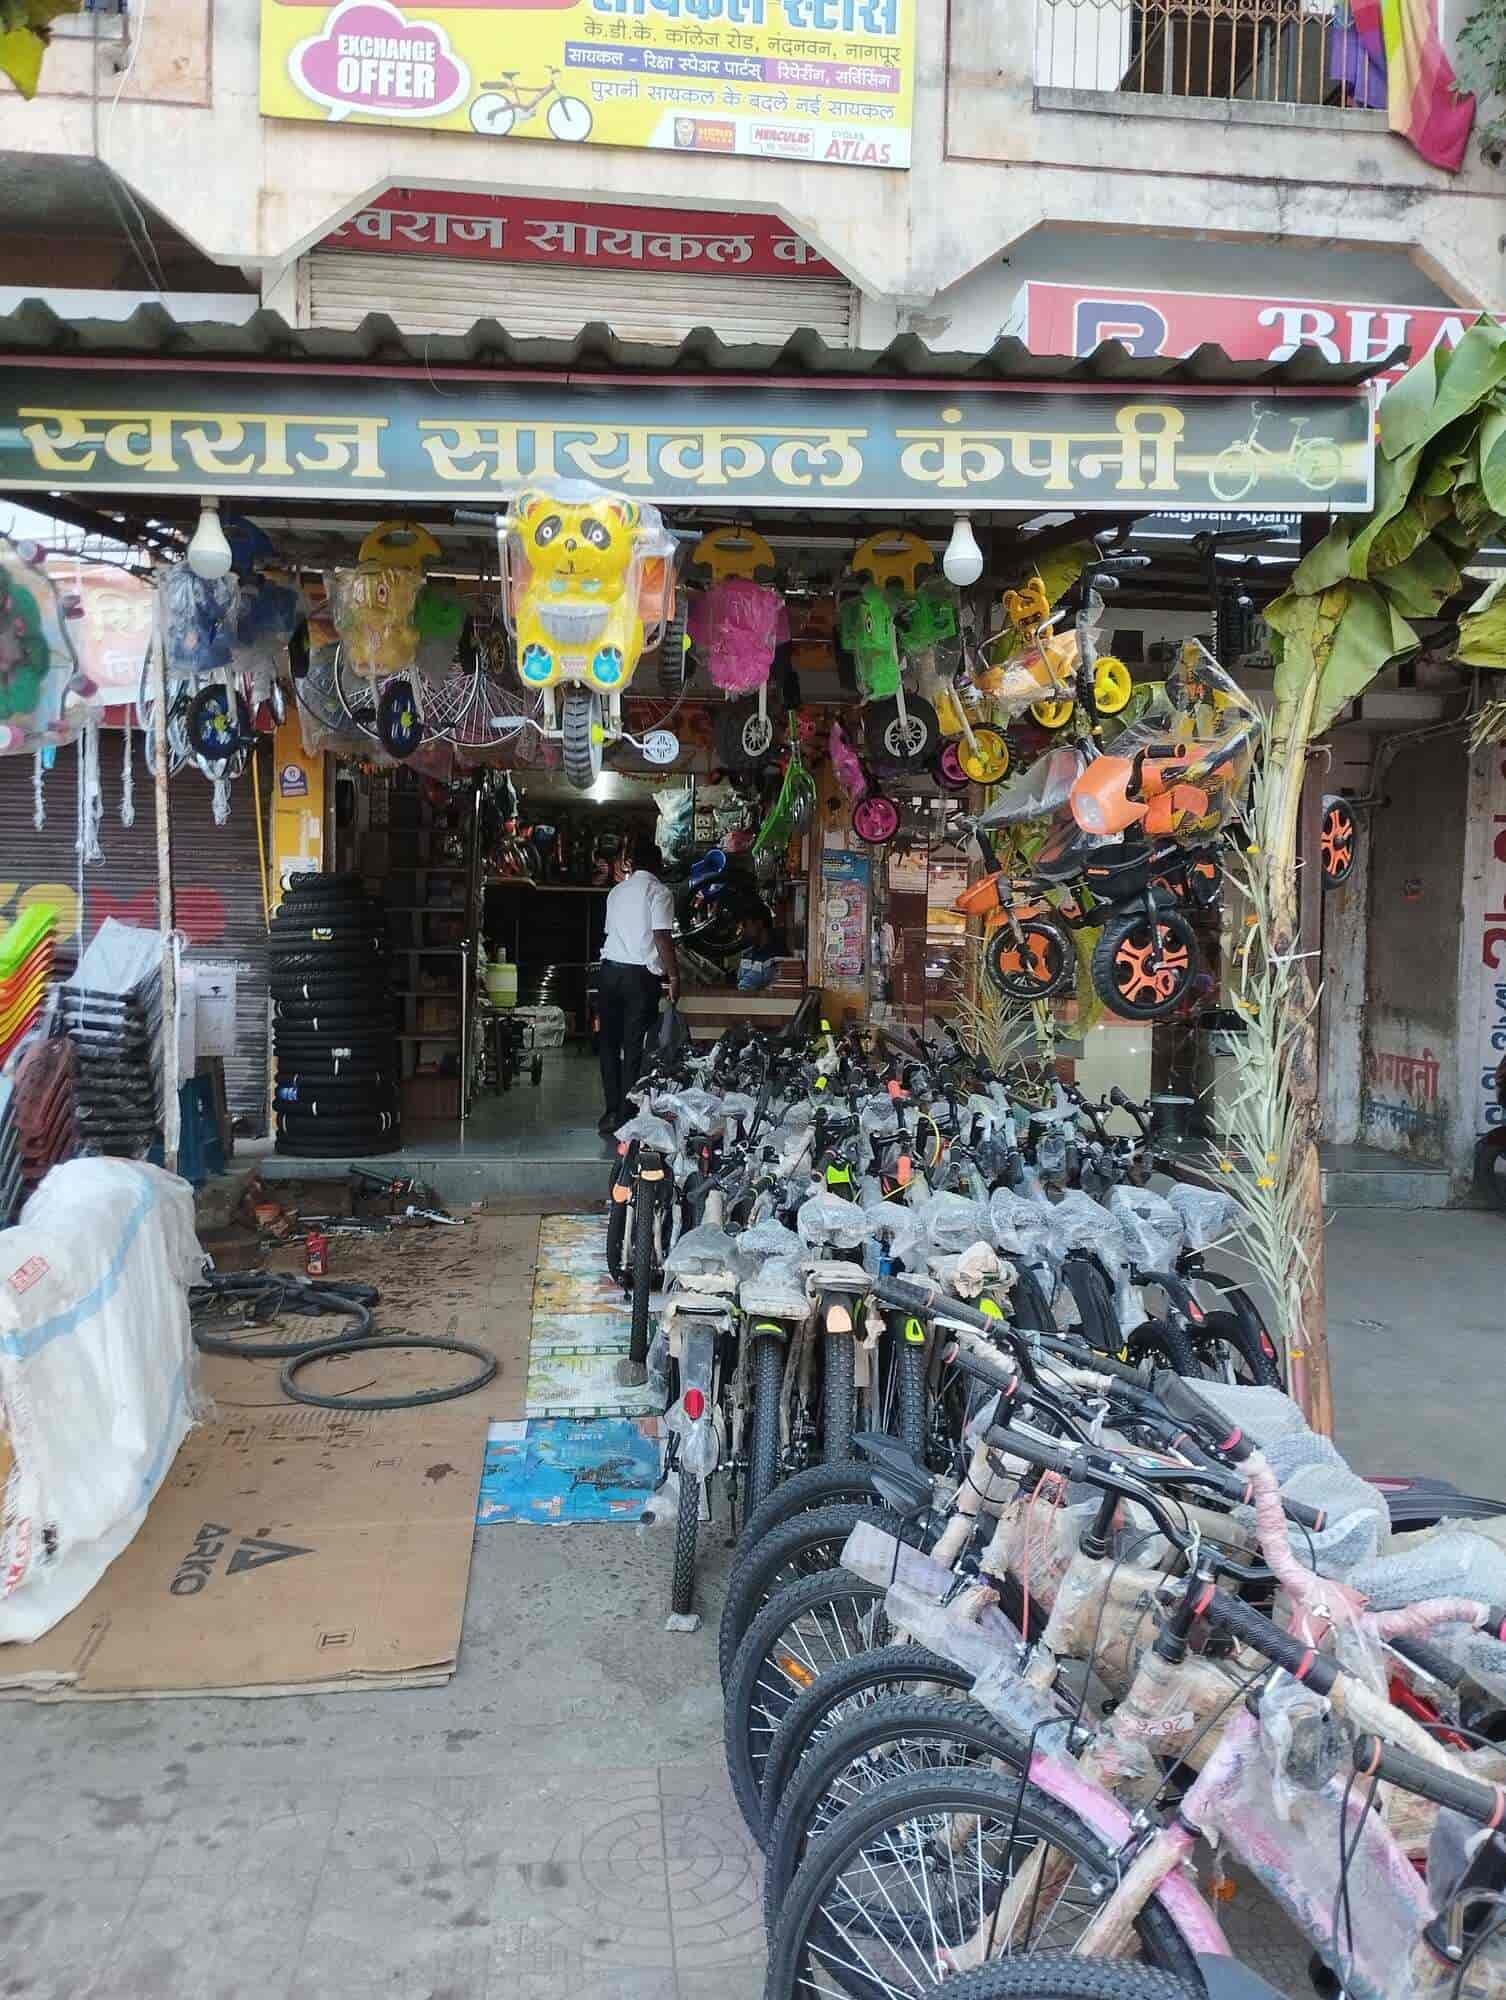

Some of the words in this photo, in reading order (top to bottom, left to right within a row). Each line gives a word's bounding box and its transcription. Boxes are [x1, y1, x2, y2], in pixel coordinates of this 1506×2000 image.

[337, 35, 436, 62] EXCHANGE
[568, 48, 624, 65] सायकल
[643, 50, 673, 71] रिक्षा
[665, 25, 720, 48] कॉलेज
[844, 43, 902, 69] नागपूर
[337, 57, 436, 99] OFFER
[591, 78, 639, 102] पुरानी
[648, 86, 714, 105] सायकल
[722, 85, 741, 106] के
[748, 90, 789, 113] बदले
[796, 93, 821, 116] नई
[828, 100, 896, 120] सायकल
[824, 138, 892, 163] ATLAS
[523, 219, 756, 263] सायकल
[17, 406, 391, 478] स्वराज
[416, 418, 869, 489] सायकल
[895, 404, 1186, 490] कंपनी
